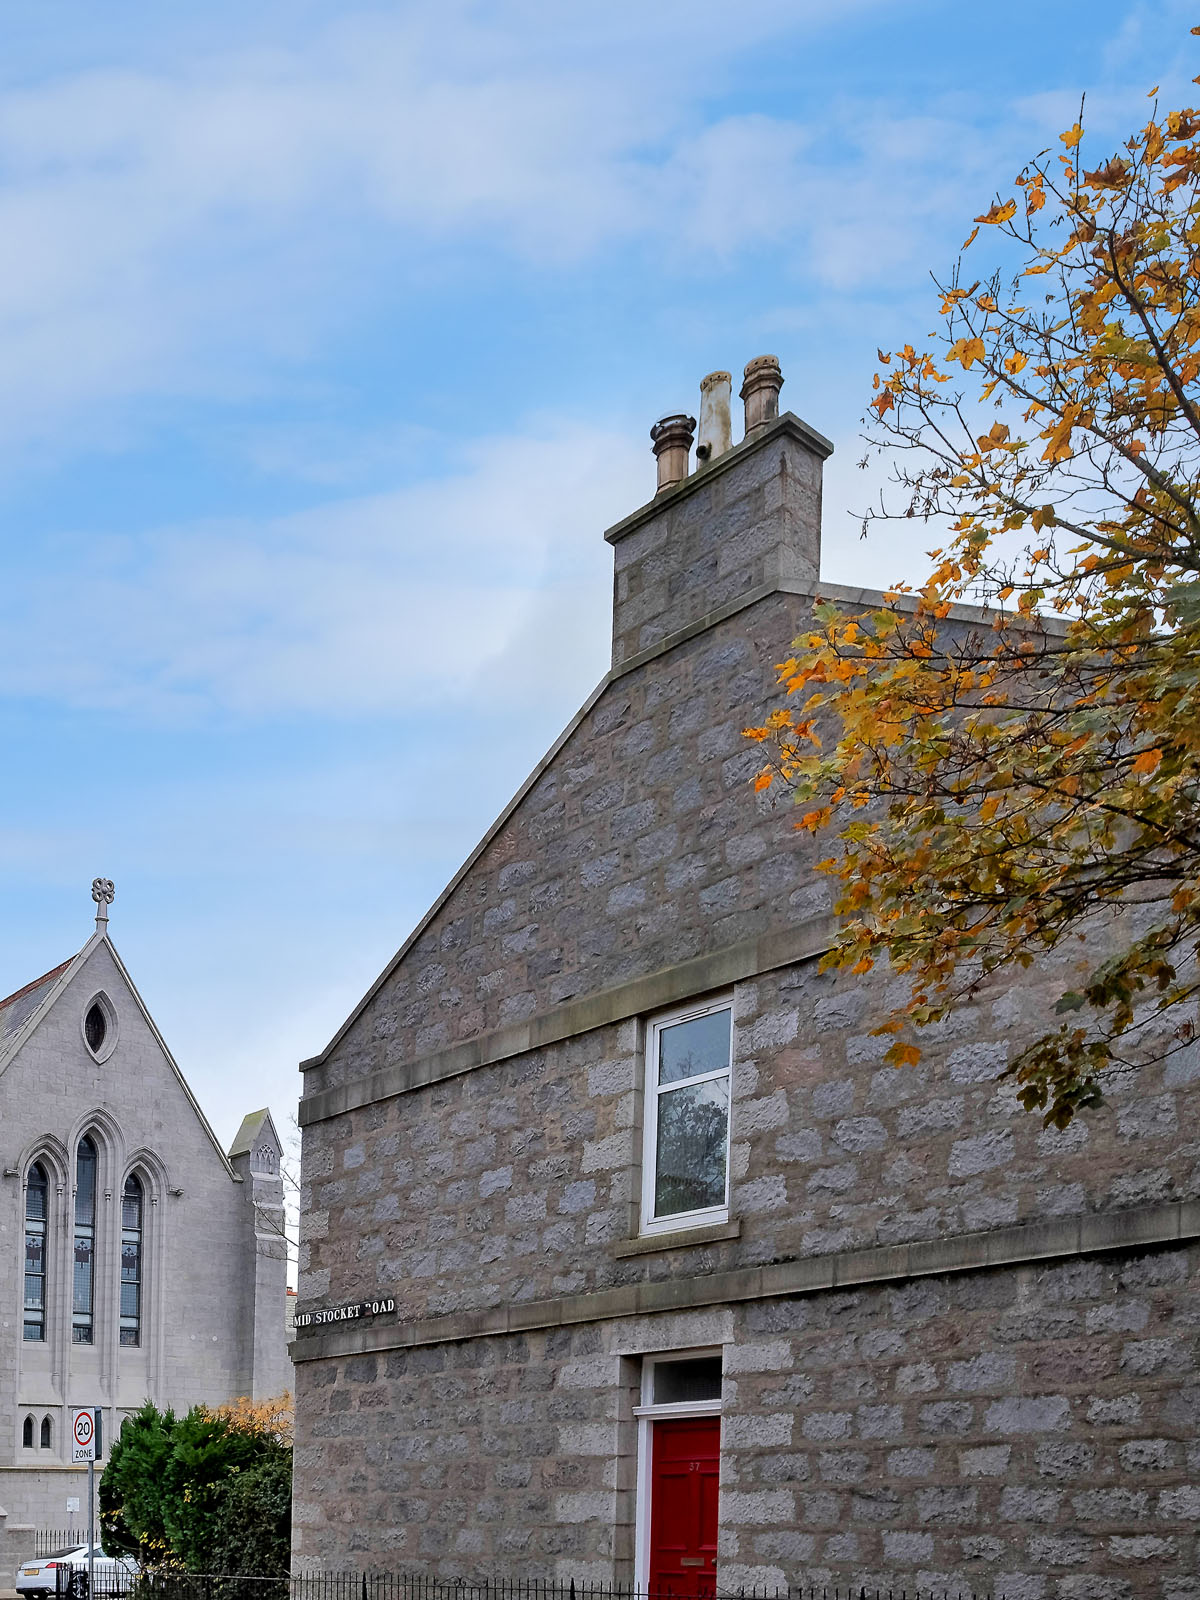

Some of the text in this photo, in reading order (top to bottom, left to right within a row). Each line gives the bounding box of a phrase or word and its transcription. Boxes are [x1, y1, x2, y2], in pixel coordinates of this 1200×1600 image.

[315, 1304, 360, 1324] STOCKET
[77, 1422, 90, 1436] 20
[75, 1449, 92, 1458] ZONE
[689, 1462, 700, 1471] 37
